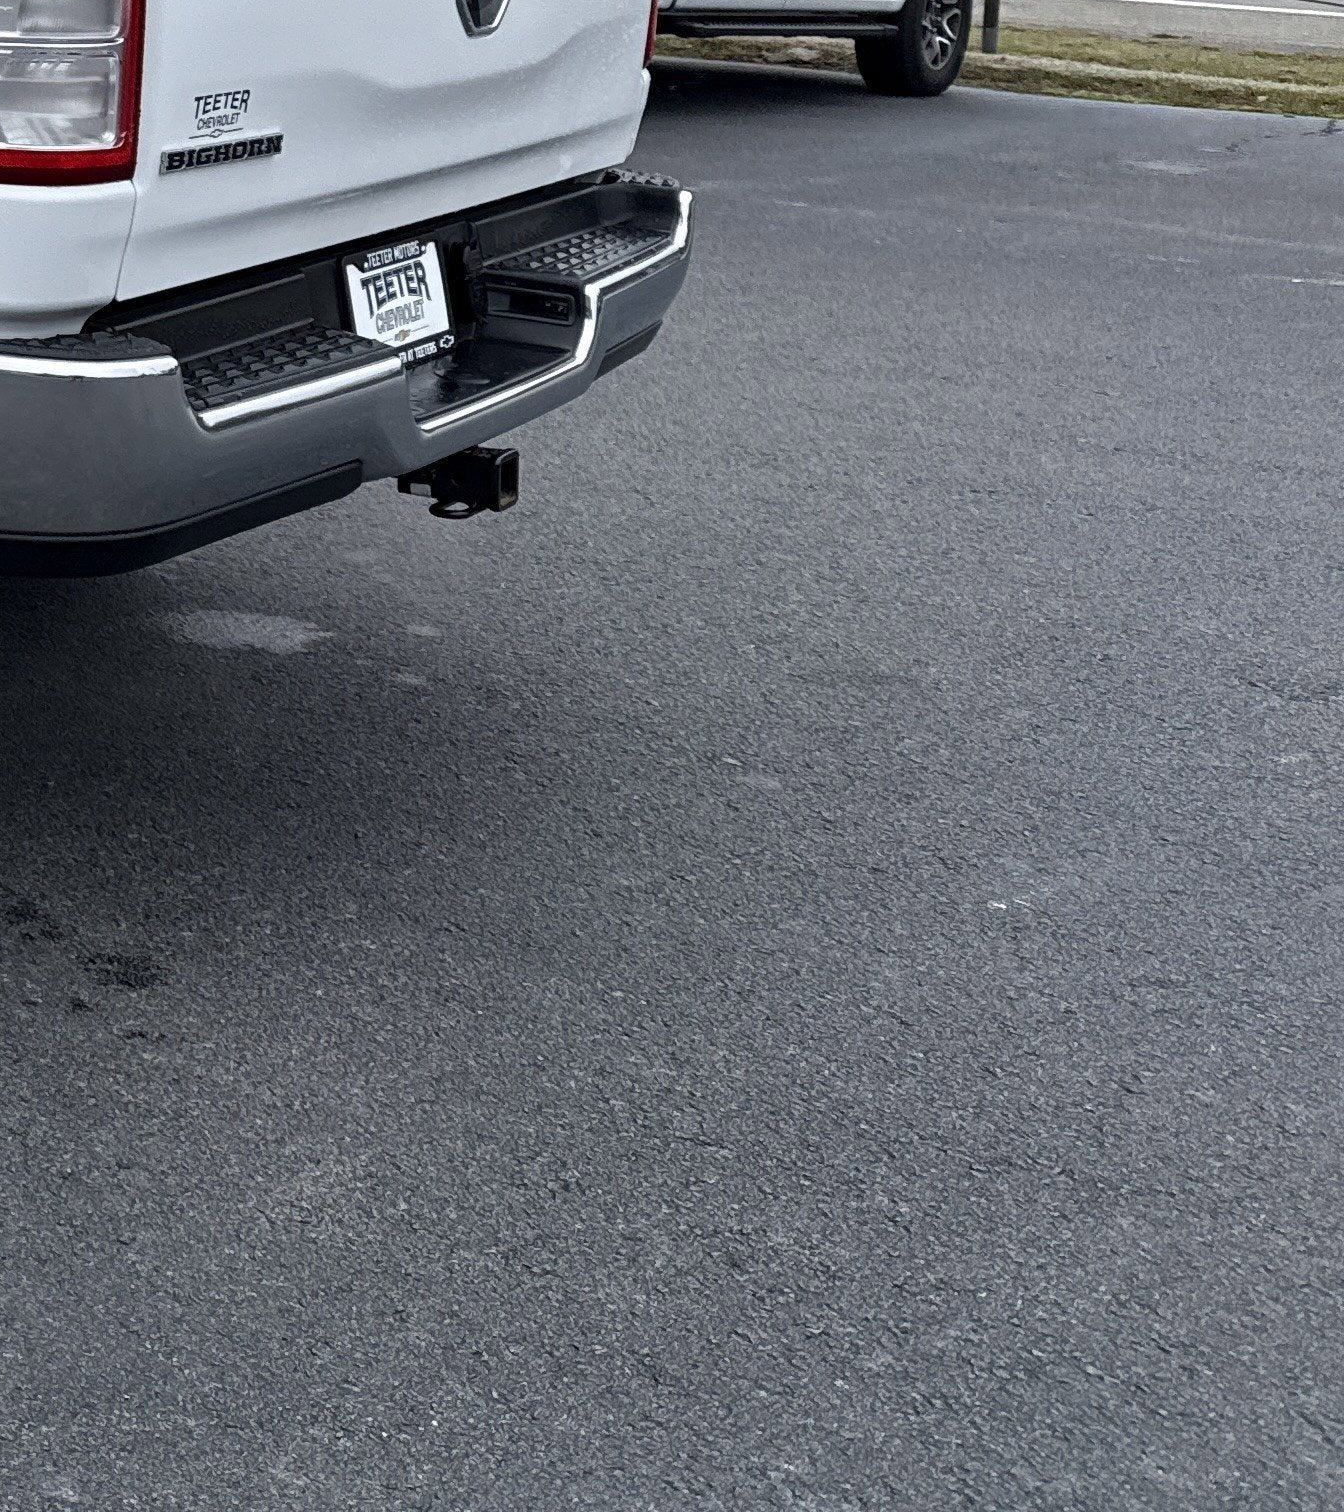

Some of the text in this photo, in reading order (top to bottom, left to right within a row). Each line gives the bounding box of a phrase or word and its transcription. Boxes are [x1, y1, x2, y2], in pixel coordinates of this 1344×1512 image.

[194, 89, 250, 119] TEETER
[197, 112, 240, 130] CHEVROLET
[164, 133, 284, 172] BIGHORN
[360, 259, 432, 319] TEETER
[376, 298, 425, 335] CHEVROLET
